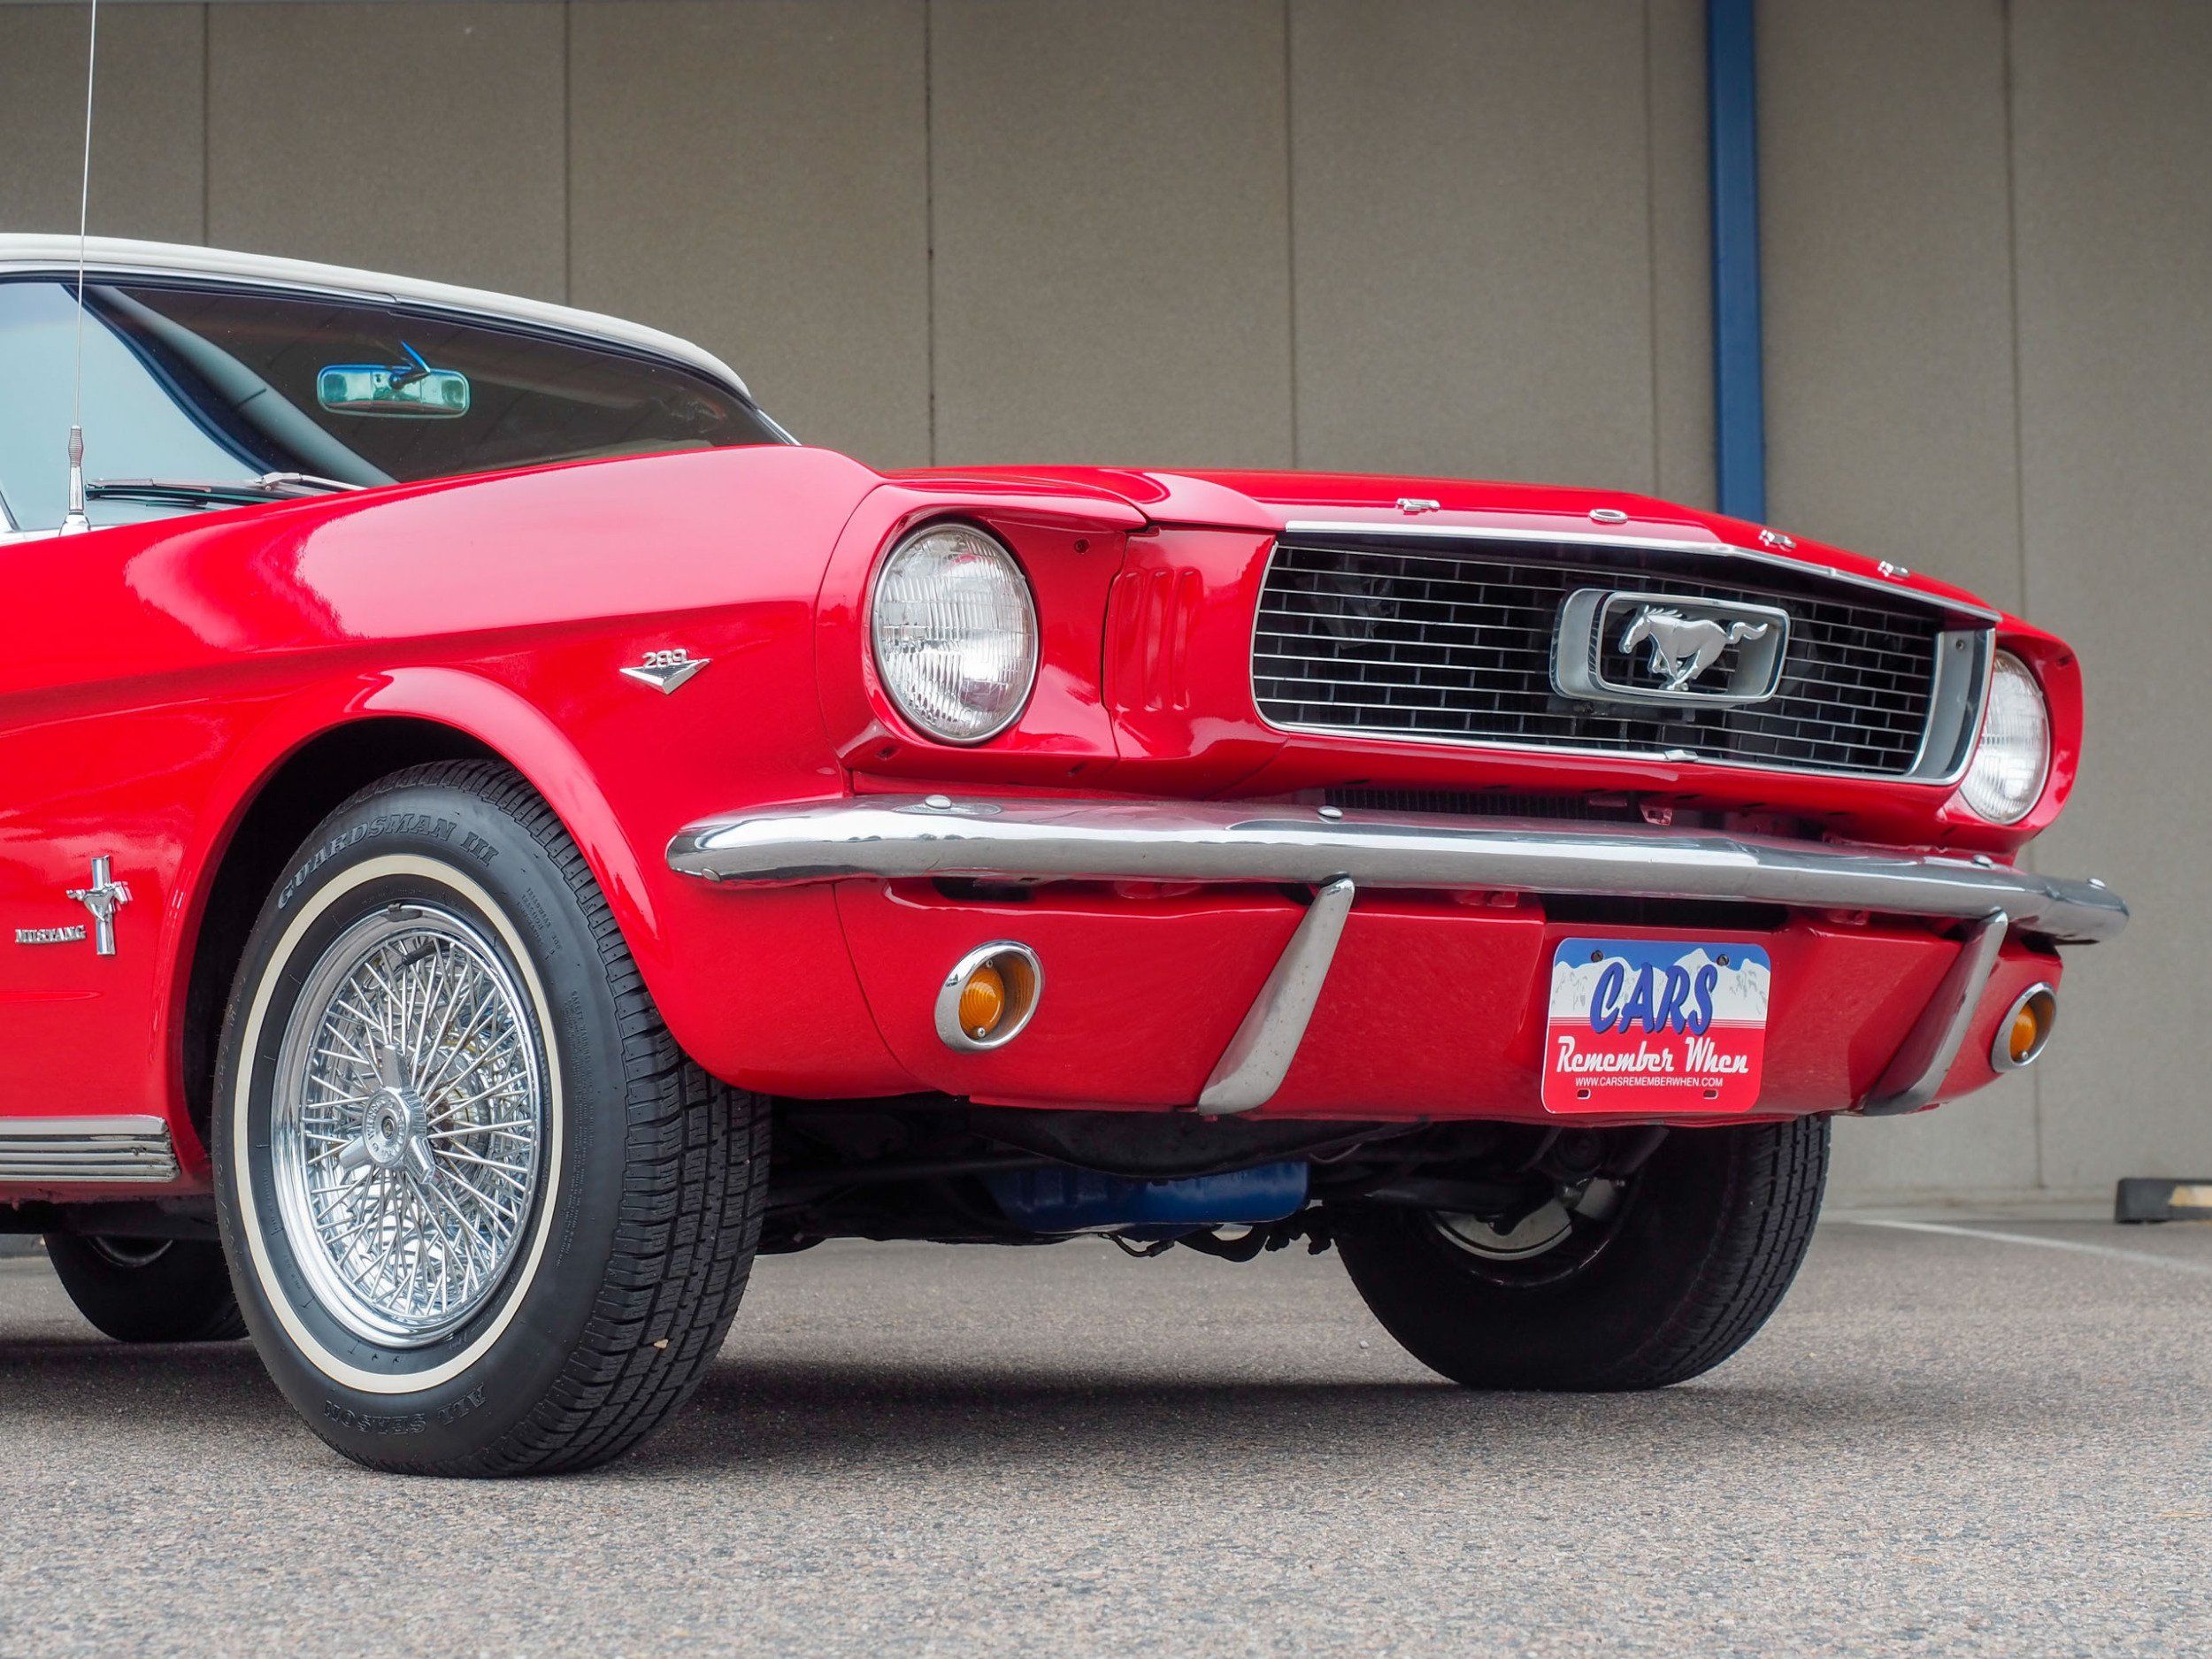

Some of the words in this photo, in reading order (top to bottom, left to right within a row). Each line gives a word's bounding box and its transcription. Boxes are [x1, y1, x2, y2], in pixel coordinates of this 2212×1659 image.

[642, 648, 688, 668] 289
[277, 813, 457, 910] GUARDSMAN
[460, 831, 500, 867] III
[16, 926, 86, 943] MUSTANG
[1590, 961, 1718, 1036] CARS
[1556, 1035, 1674, 1073] Remember
[1685, 1036, 1749, 1073] When
[1575, 1077, 1724, 1087] WWW.CARSREMEMBERWHEN.COM
[324, 1399, 427, 1435] SEASON
